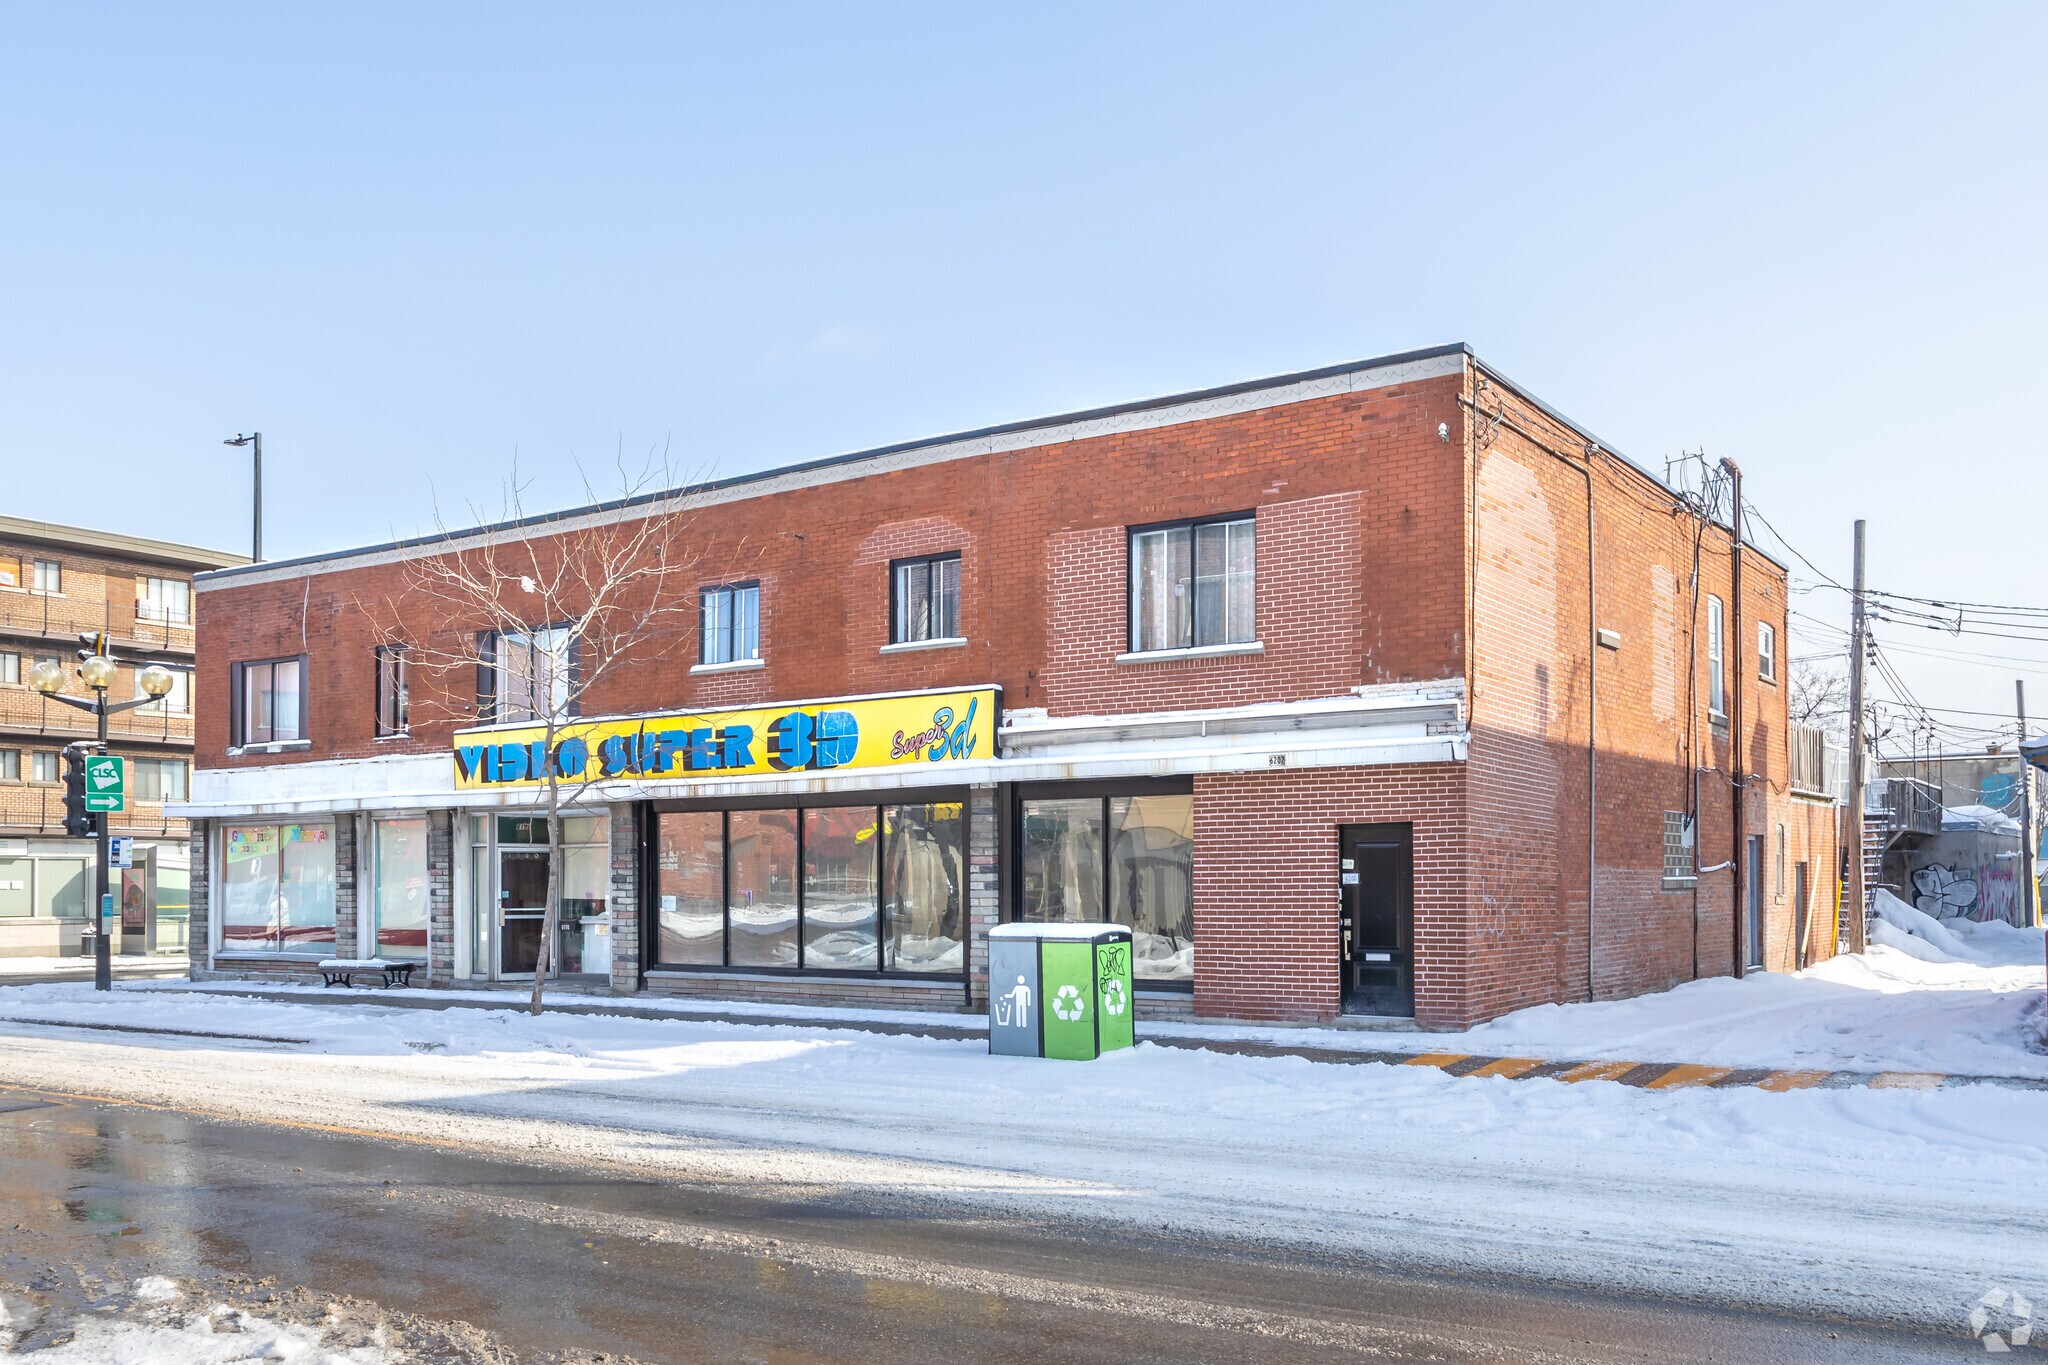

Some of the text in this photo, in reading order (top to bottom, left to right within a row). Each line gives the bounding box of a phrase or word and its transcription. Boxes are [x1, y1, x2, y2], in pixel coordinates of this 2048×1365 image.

[600, 724, 756, 776] SUPER
[768, 710, 859, 770] 3D
[891, 722, 945, 760] Super
[928, 697, 979, 762] 3d
[91, 768, 116, 778] CLSC
